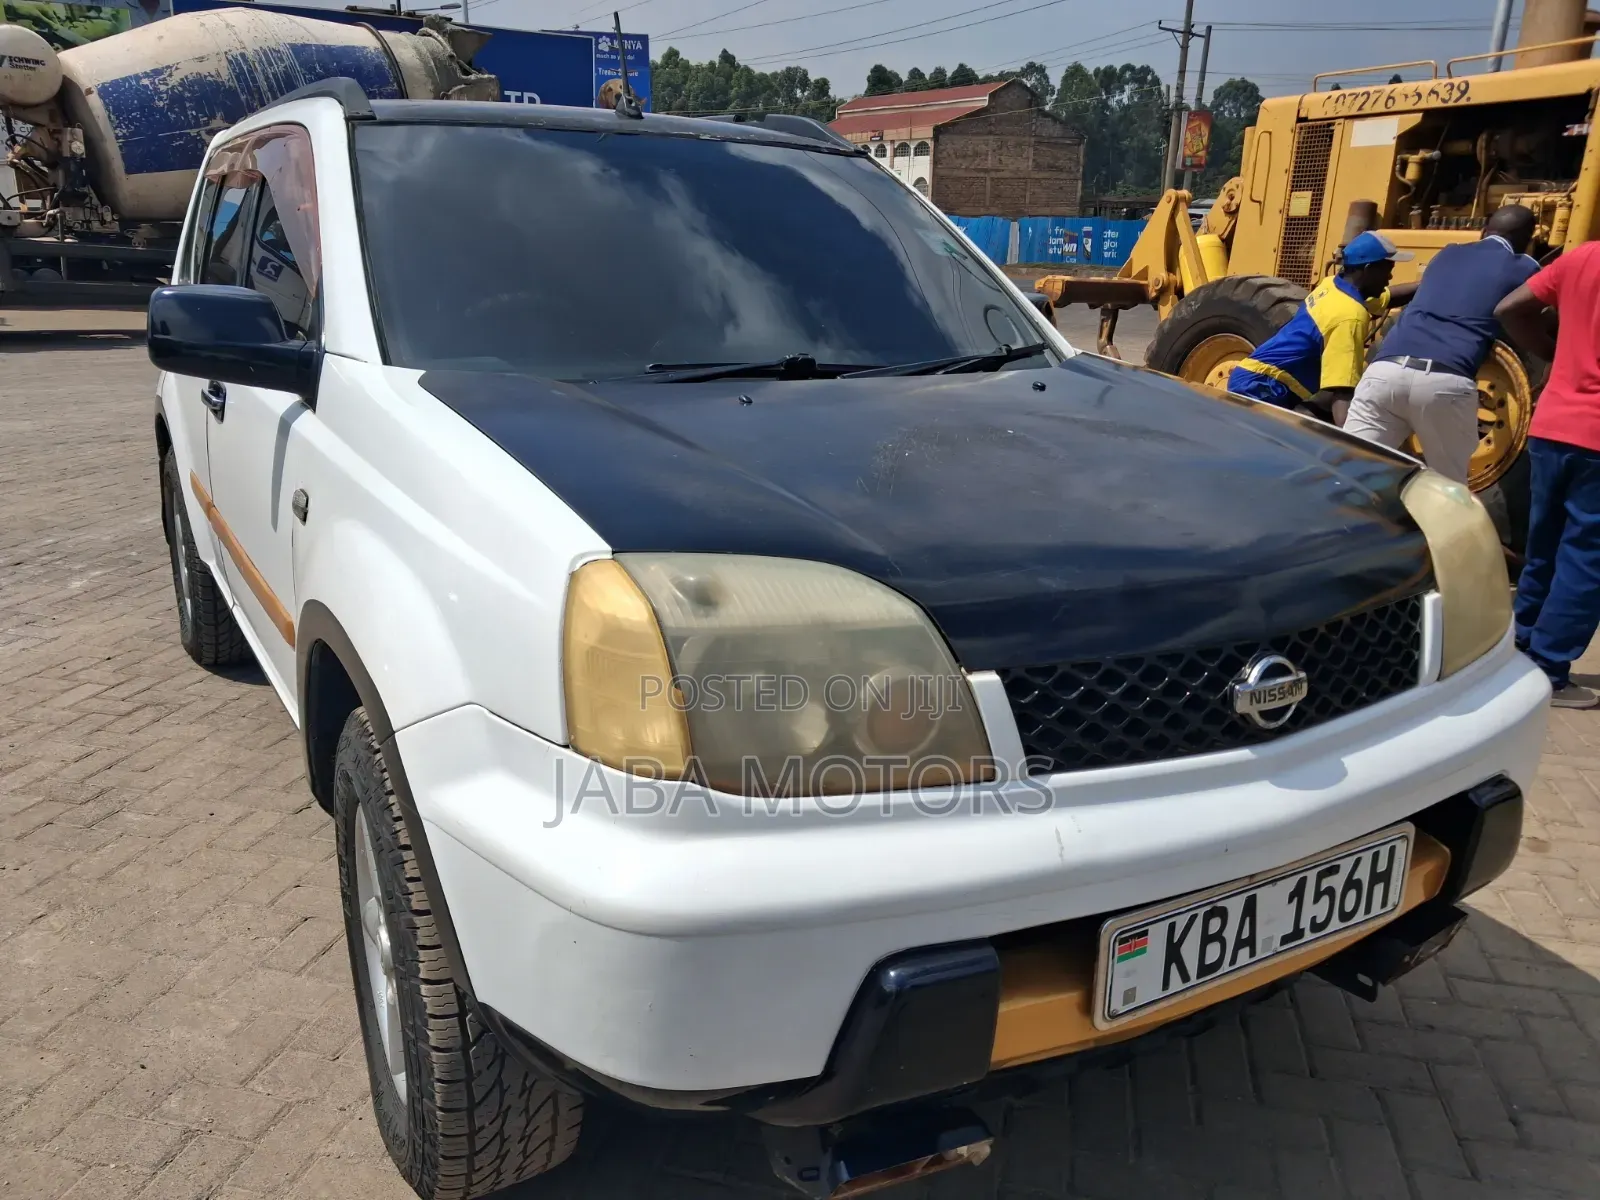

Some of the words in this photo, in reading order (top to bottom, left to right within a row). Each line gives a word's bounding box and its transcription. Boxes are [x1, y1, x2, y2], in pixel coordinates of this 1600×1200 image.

[613, 39, 643, 50] KNYA
[8, 56, 46, 66] SCHWING
[1249, 681, 1304, 706] NISSAN
[1161, 893, 1258, 992] KBA
[1279, 845, 1397, 948] 156H
